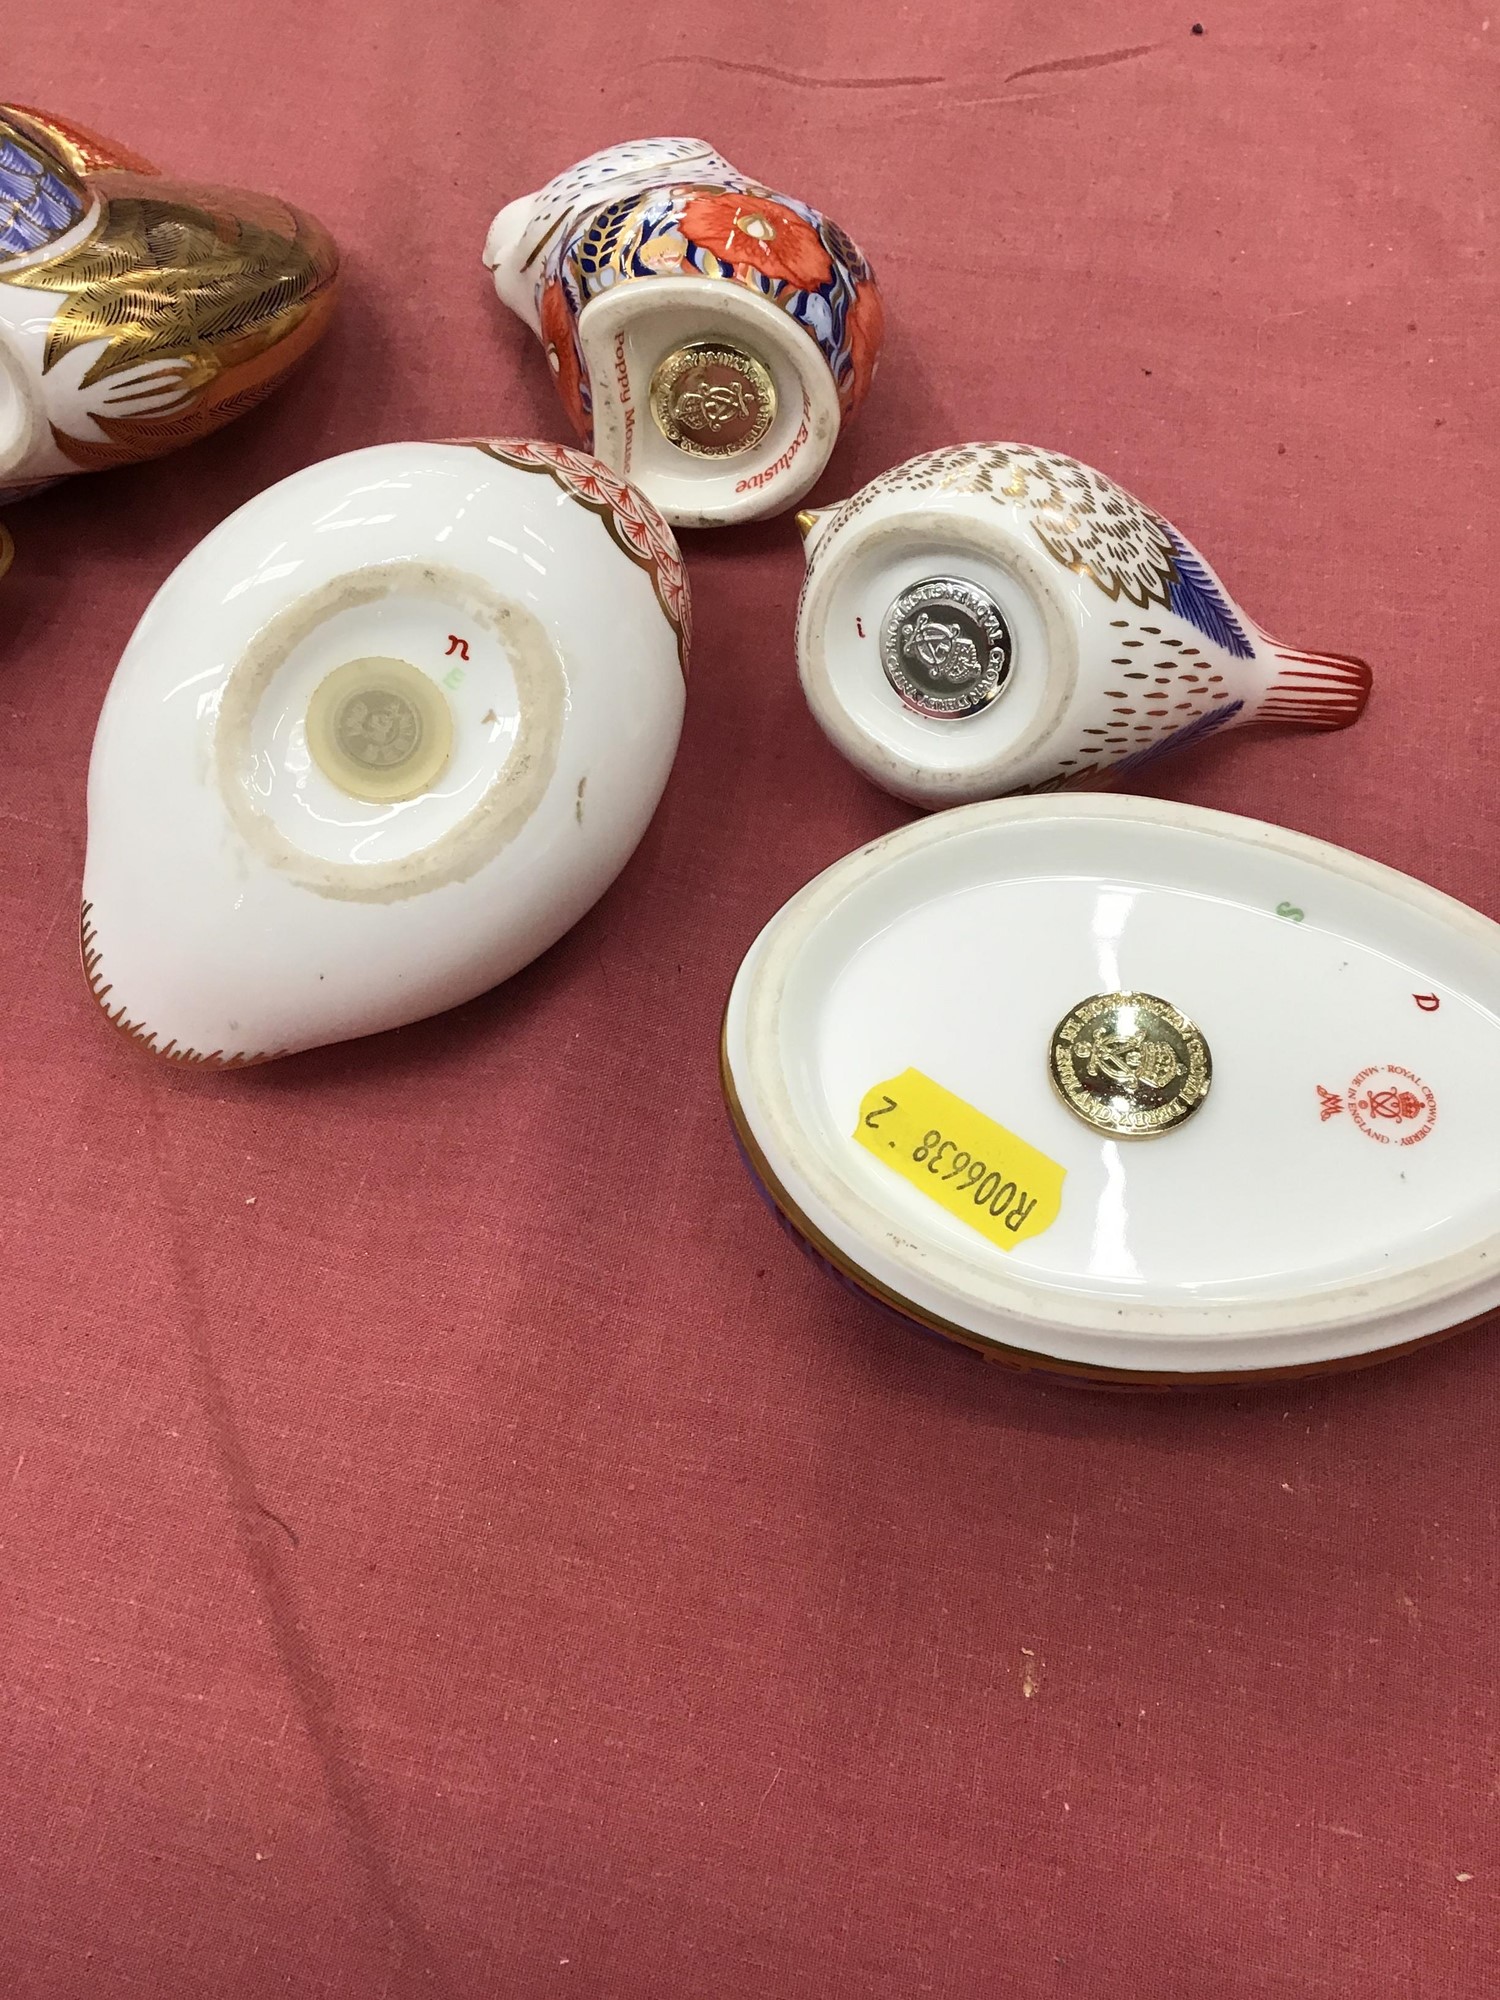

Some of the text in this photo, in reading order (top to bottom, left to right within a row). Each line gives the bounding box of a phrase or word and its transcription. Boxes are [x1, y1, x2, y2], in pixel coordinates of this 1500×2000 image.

[614, 330, 636, 474] Poppy Mouse
[735, 422, 808, 493] Exclusive
[1347, 1065, 1390, 1144] MADE IN ENGLAND
[1387, 1064, 1437, 1146] ROYAL CROWN DERBY
[865, 1095, 1038, 1232] R006638 2
